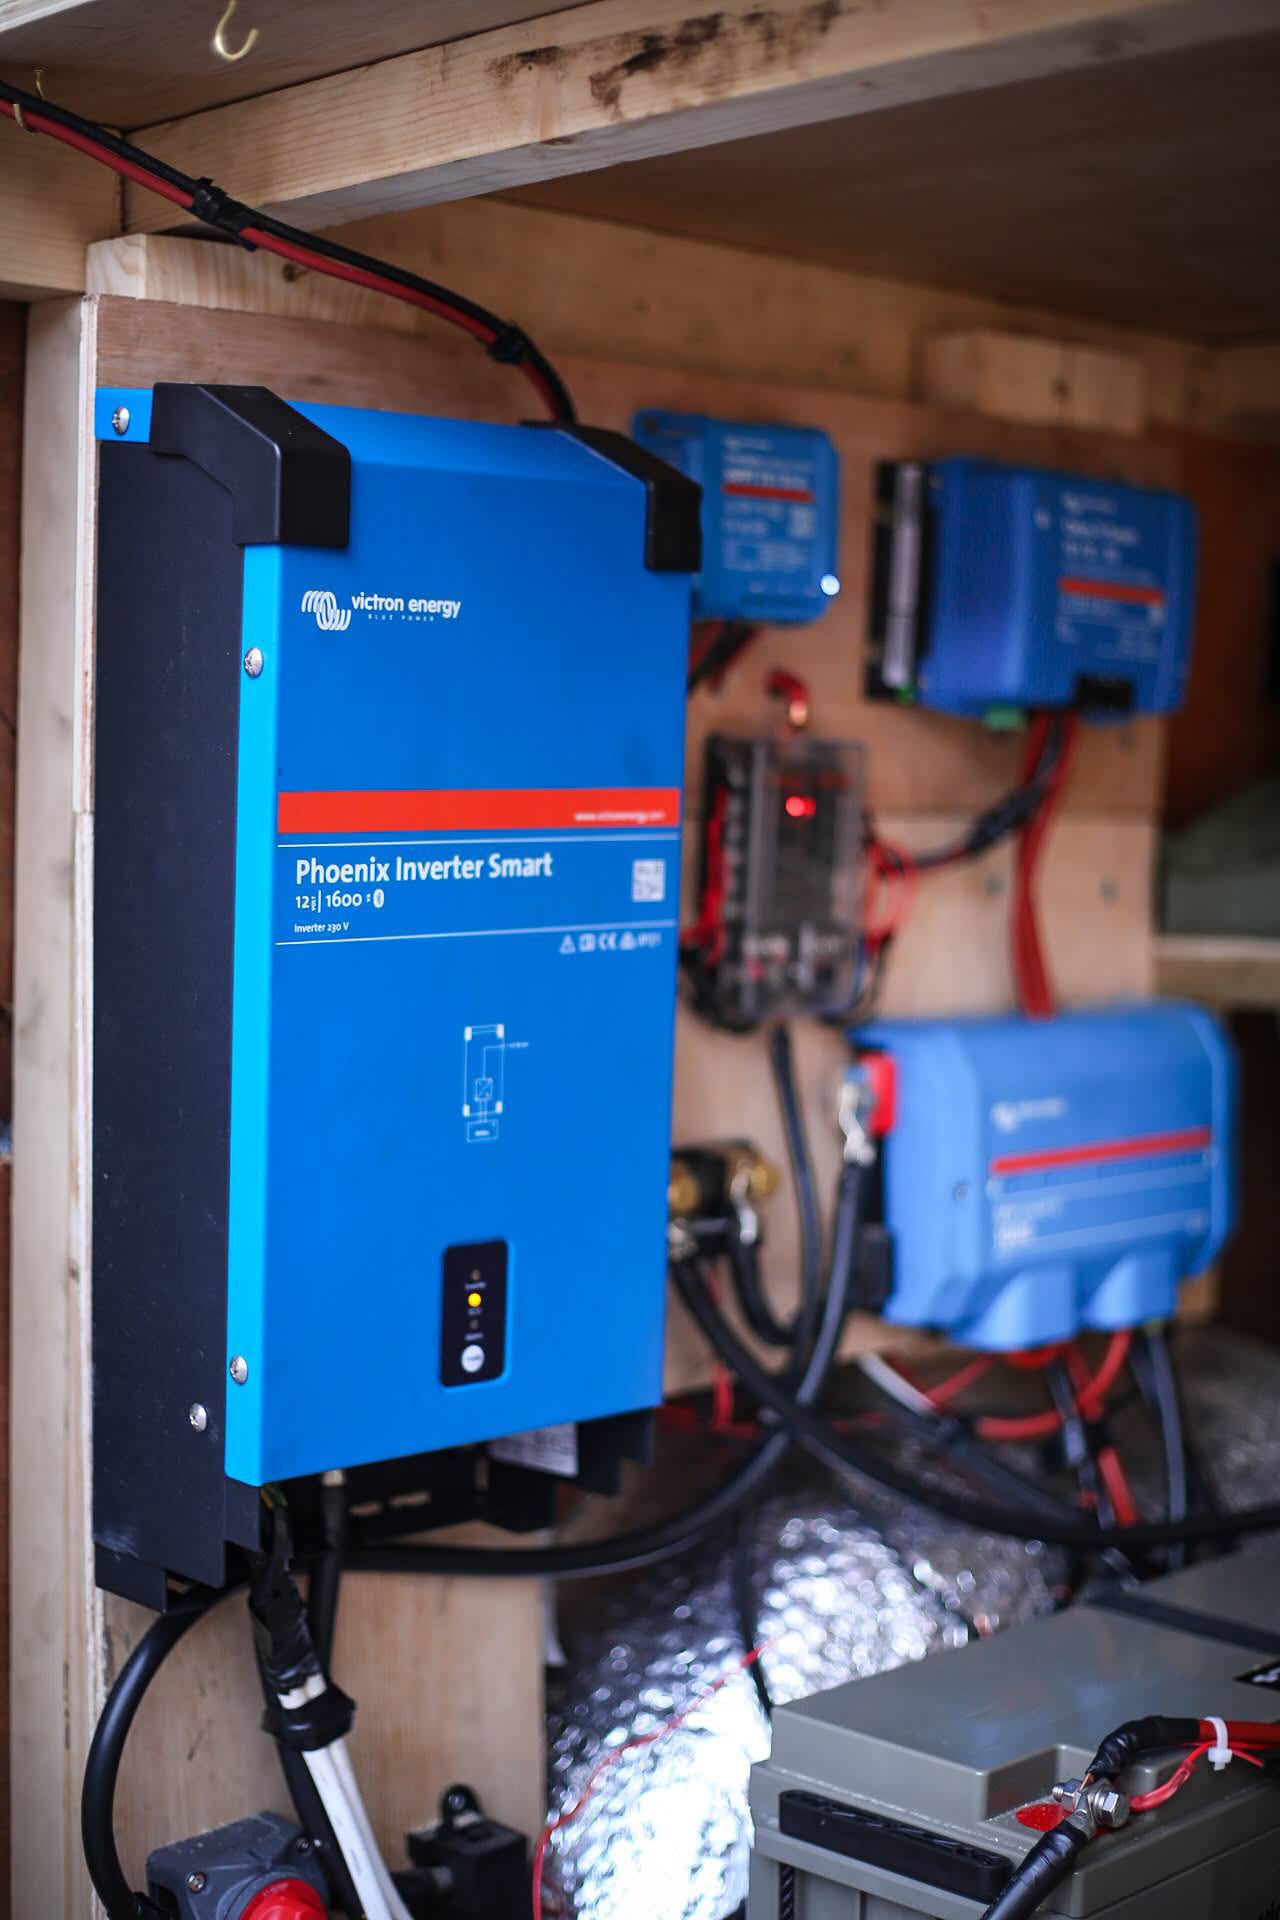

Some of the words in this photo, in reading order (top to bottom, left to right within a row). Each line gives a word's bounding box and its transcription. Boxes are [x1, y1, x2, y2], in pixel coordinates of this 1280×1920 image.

[351, 591, 404, 612] victron
[408, 598, 461, 619] energy
[368, 613, 394, 621] BLUE
[401, 614, 435, 622] POWER
[296, 856, 391, 885] Phoenix
[396, 855, 484, 881] Inverter
[488, 851, 553, 878] Smart
[295, 895, 310, 909] 12
[325, 889, 363, 908] 1600
[294, 923, 326, 933] Inverter
[327, 922, 342, 934] 230
[342, 921, 349, 931] V
